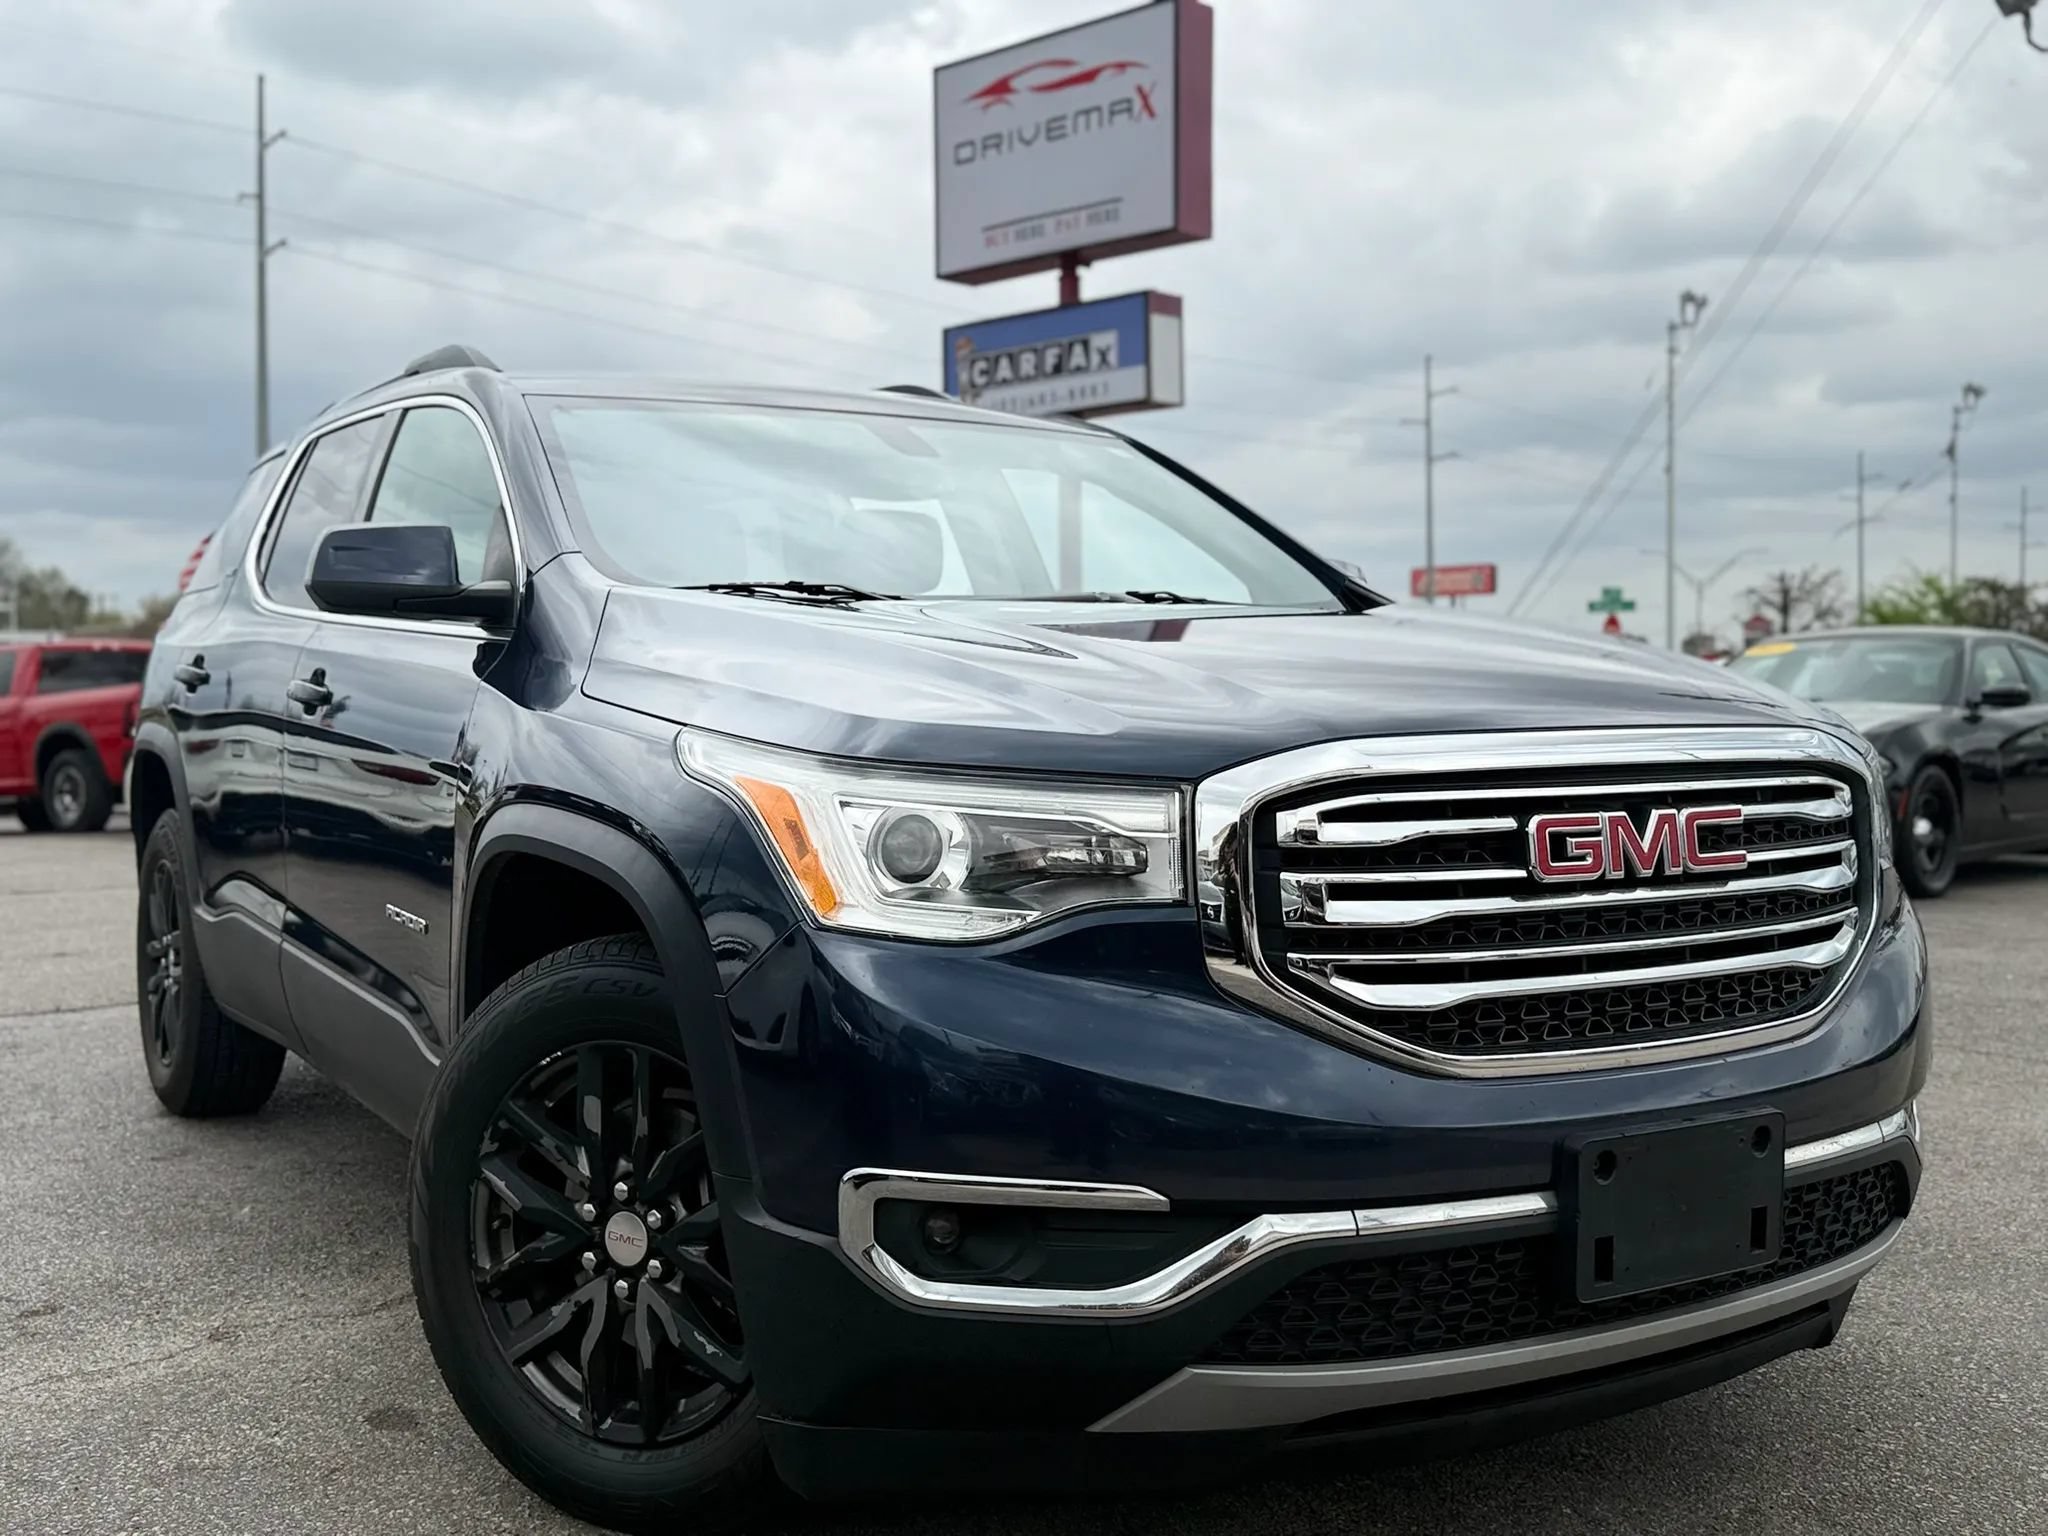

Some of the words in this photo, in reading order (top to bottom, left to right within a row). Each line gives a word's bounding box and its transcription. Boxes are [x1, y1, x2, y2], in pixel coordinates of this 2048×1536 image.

[953, 81, 1157, 167] DRIVEMAX
[970, 338, 1114, 388] CARFAX
[1528, 805, 1748, 882] GMC
[608, 1230, 643, 1248] GMC
